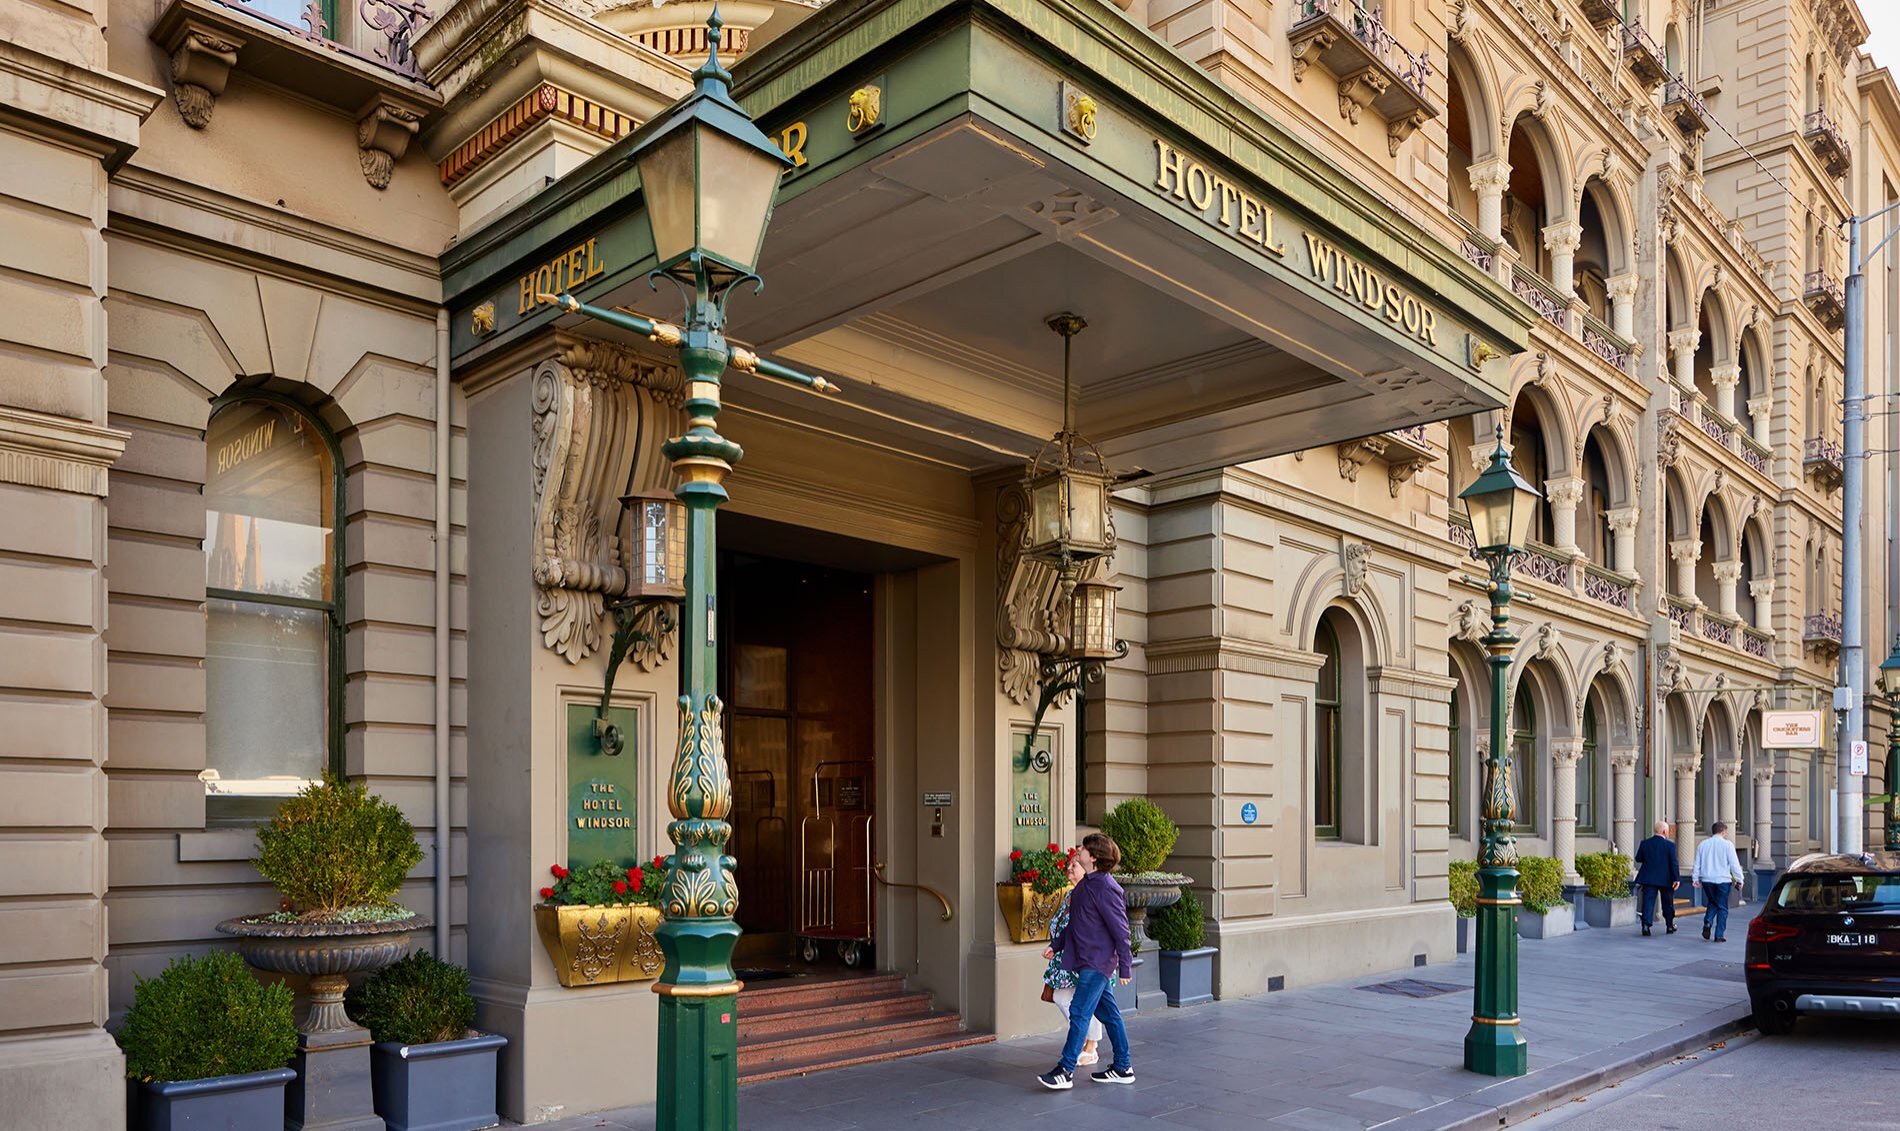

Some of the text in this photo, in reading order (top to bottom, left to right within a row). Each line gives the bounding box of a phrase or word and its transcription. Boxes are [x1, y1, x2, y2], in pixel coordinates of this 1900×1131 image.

[1154, 138, 1438, 346] HOTEL WINDSOR
[518, 238, 604, 315] HOTEL
[591, 783, 615, 793] THE
[1024, 792, 1039, 800] THE
[583, 799, 622, 811] HOTEL
[1020, 803, 1042, 813] HOTEL
[576, 817, 631, 829] WINDSOR
[1016, 816, 1047, 826] WINDSOR
